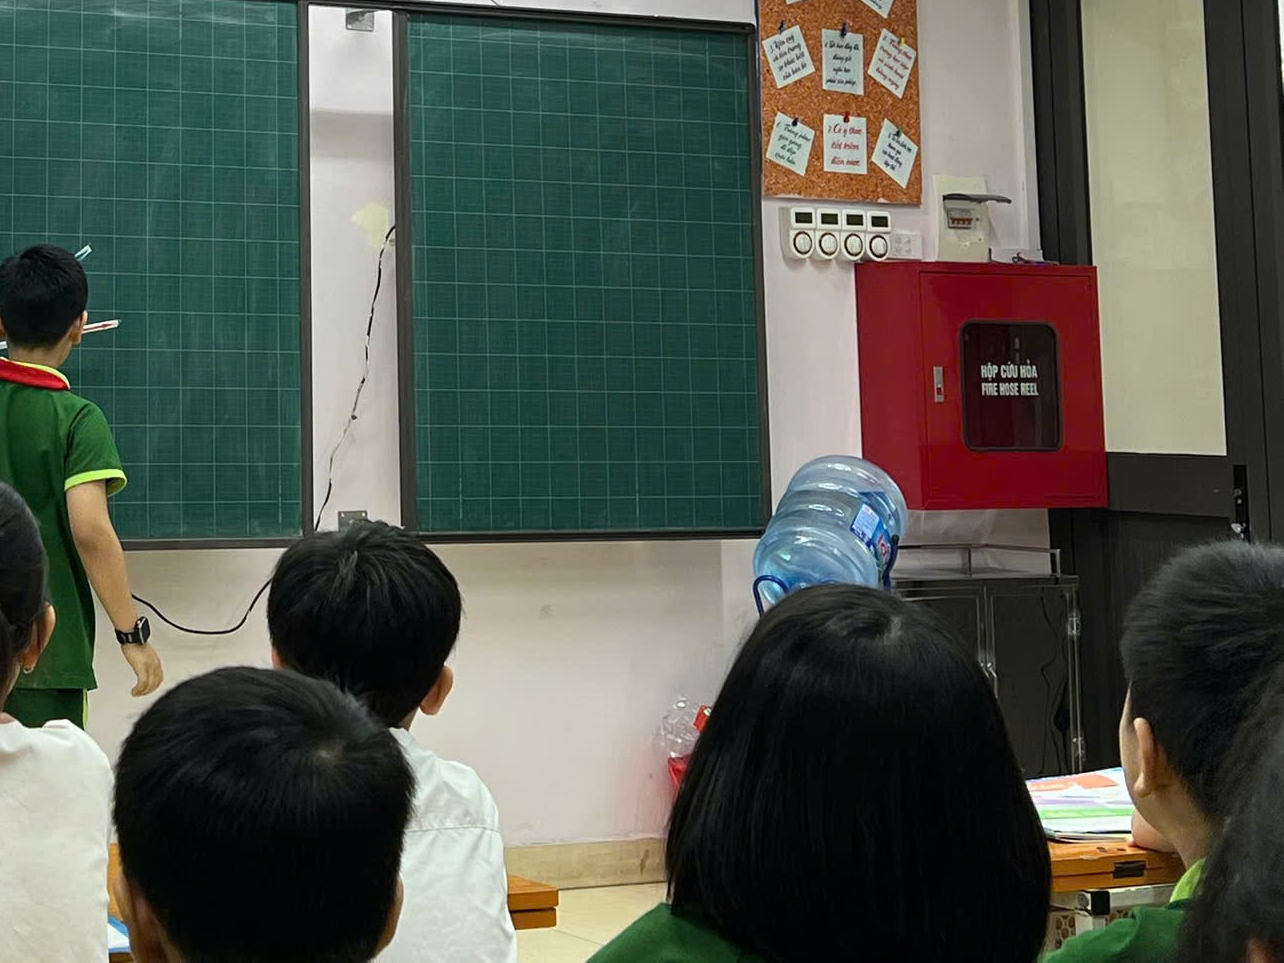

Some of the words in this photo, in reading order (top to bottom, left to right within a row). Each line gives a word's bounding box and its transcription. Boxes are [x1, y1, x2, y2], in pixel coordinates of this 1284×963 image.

[981, 362, 998, 381] HỘP
[1000, 360, 1018, 378] CỨU
[1019, 358, 1038, 378] HỎA
[981, 382, 998, 396] FIRE
[999, 382, 1019, 396] HOSE
[1020, 382, 1039, 396] REEL
